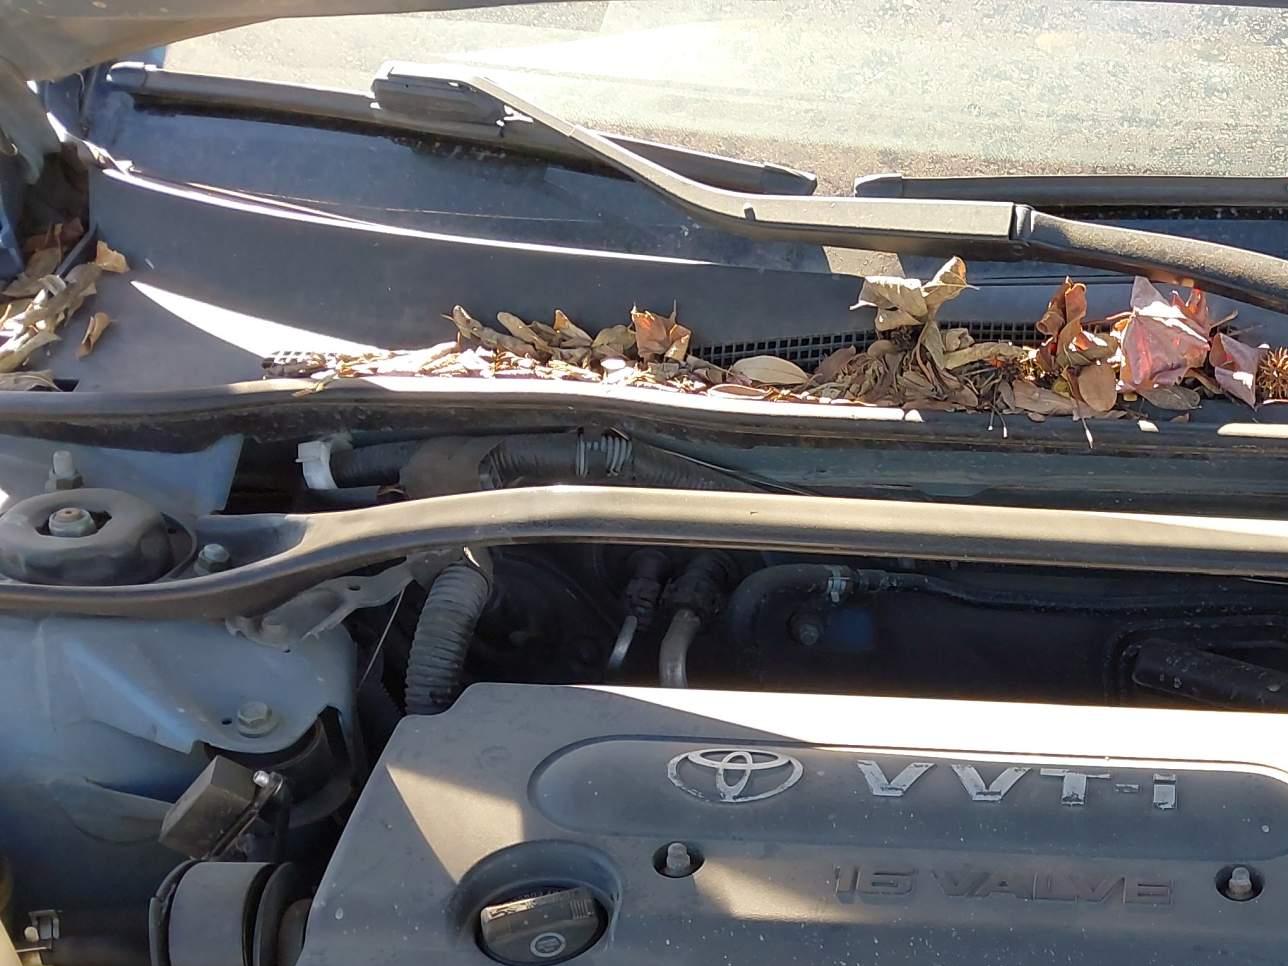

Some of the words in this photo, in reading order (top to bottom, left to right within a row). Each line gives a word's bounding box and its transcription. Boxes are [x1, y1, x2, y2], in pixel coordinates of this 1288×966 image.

[857, 760, 1177, 810] VVT-i
[834, 865, 917, 898] 16
[930, 867, 1176, 906] VALVE
